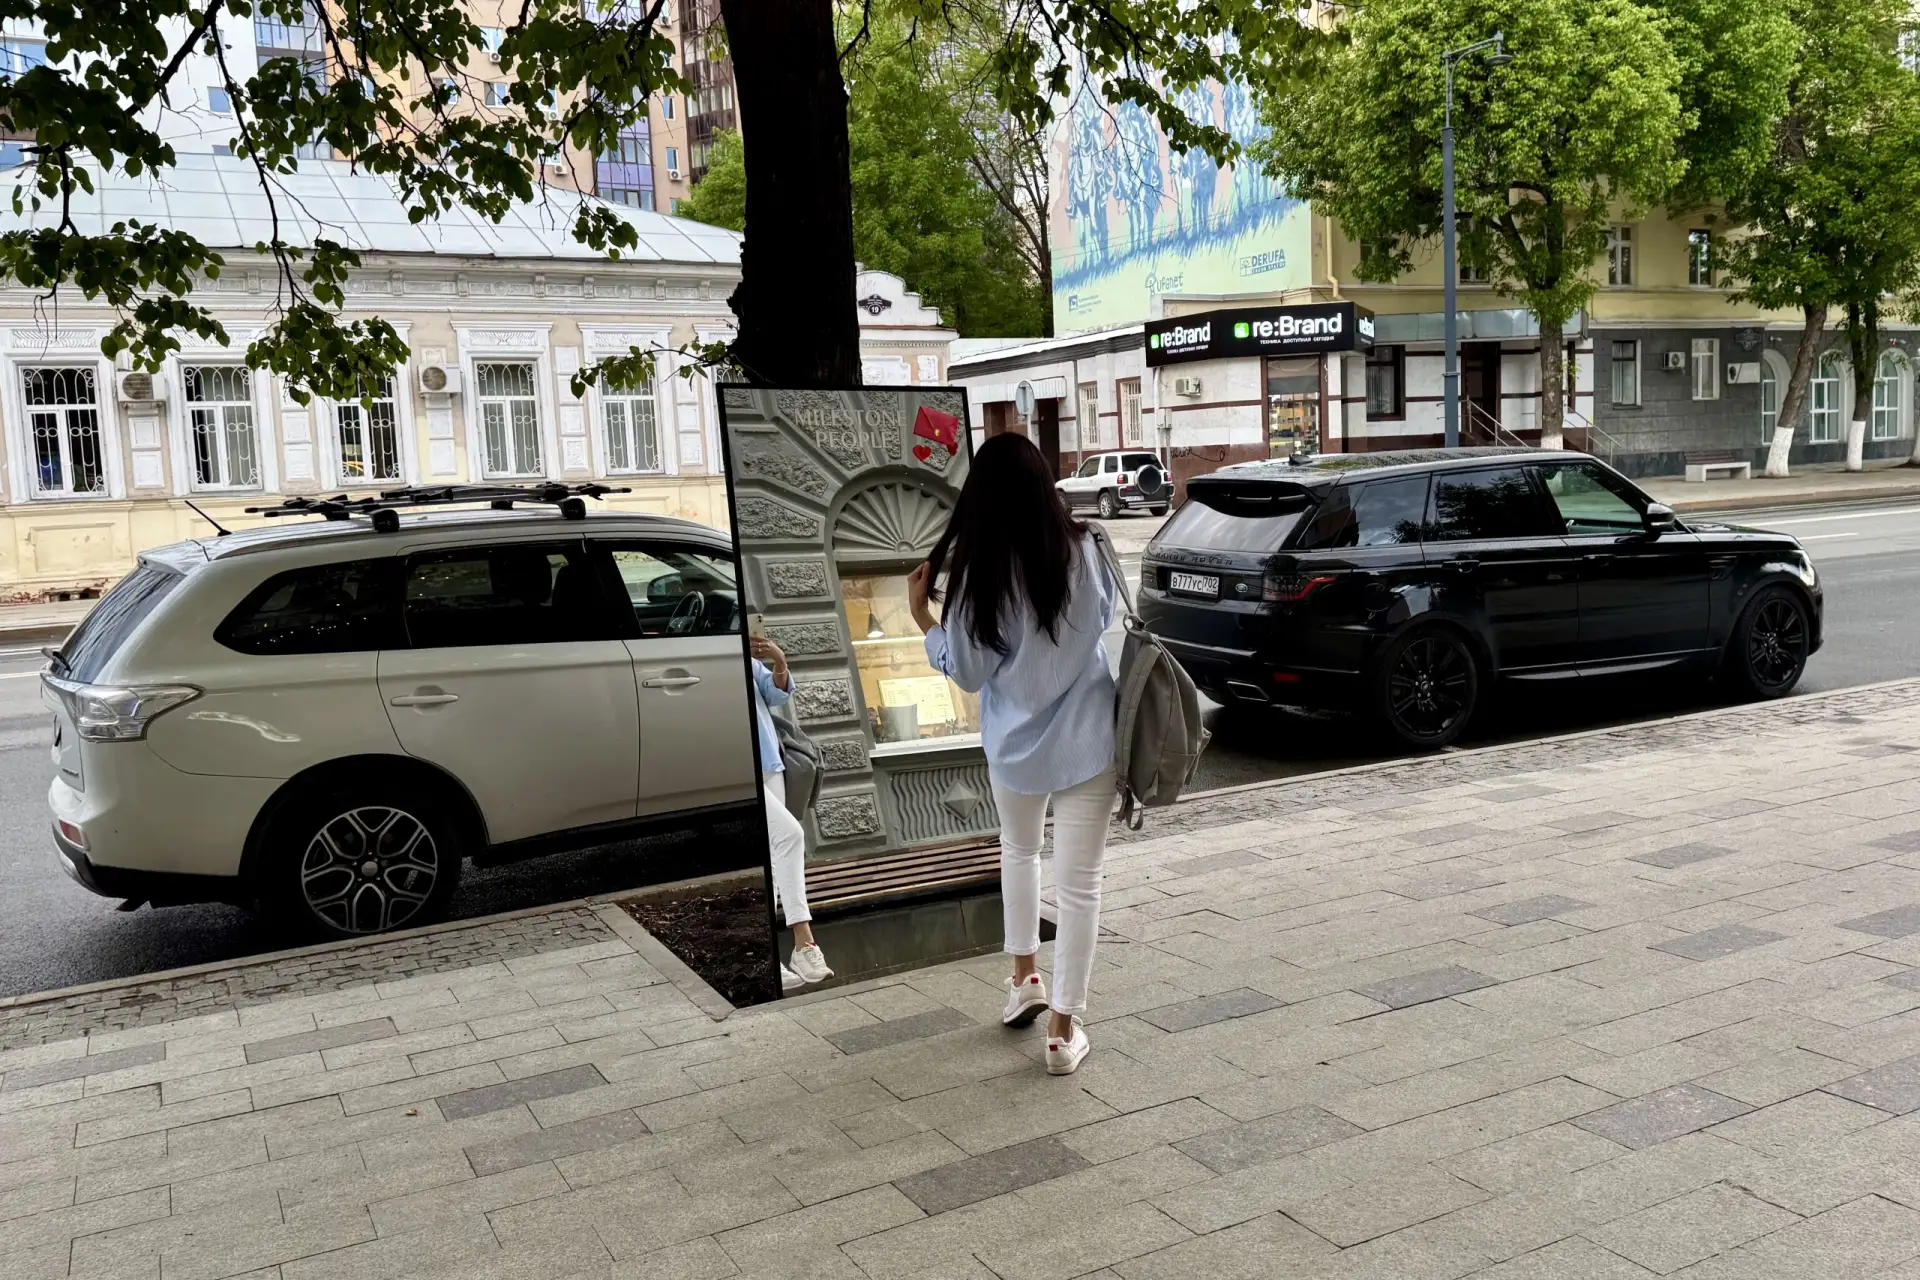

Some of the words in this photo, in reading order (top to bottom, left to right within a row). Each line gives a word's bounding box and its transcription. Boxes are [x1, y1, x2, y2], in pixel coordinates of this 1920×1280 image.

[1252, 249, 1286, 267] DERUFA
[871, 306, 880, 314] 19
[1160, 321, 1211, 348] re:Brand
[1253, 312, 1342, 338] re:Brand
[795, 408, 908, 428] MILESTONE
[815, 430, 893, 449] PEOPLE
